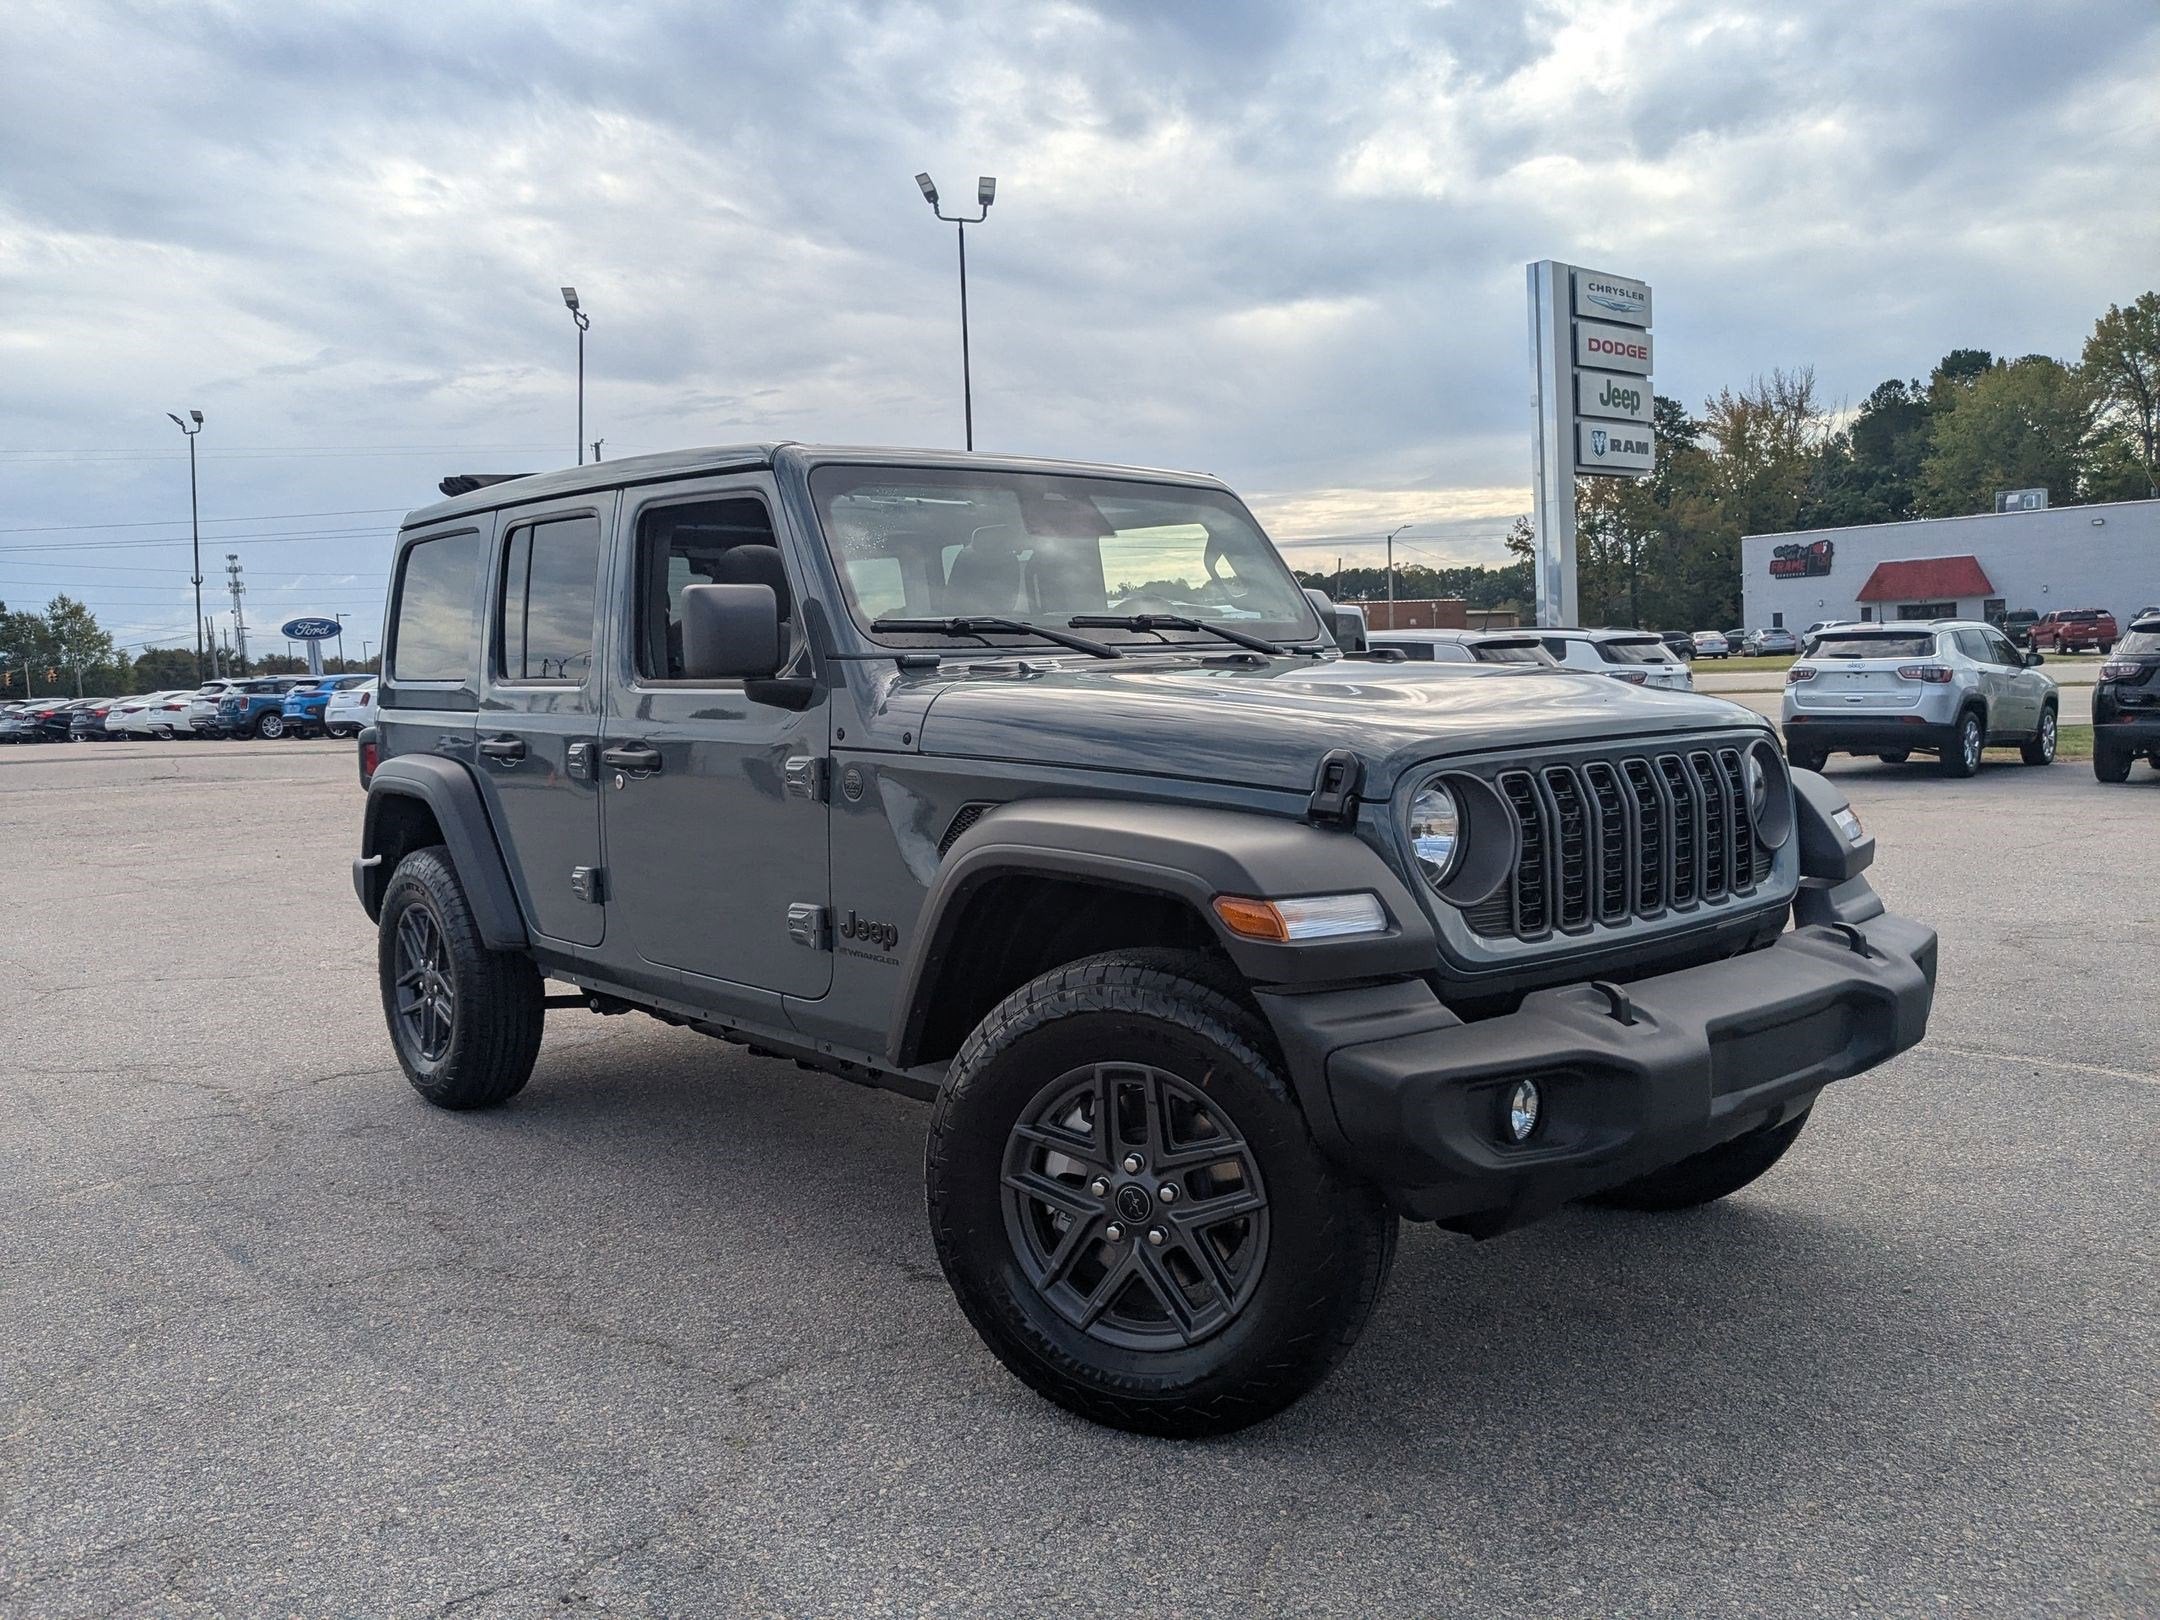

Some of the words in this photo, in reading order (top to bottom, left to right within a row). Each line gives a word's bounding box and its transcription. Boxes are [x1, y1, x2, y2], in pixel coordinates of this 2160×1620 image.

[1588, 282, 1645, 301] CHRYSLER
[1588, 338, 1648, 360] DODGE
[1600, 379, 1640, 415] Jeep
[1610, 439, 1649, 455] RAM
[294, 622, 330, 636] Ford
[840, 910, 898, 951] Jeep
[848, 948, 900, 966] WRANGLER
